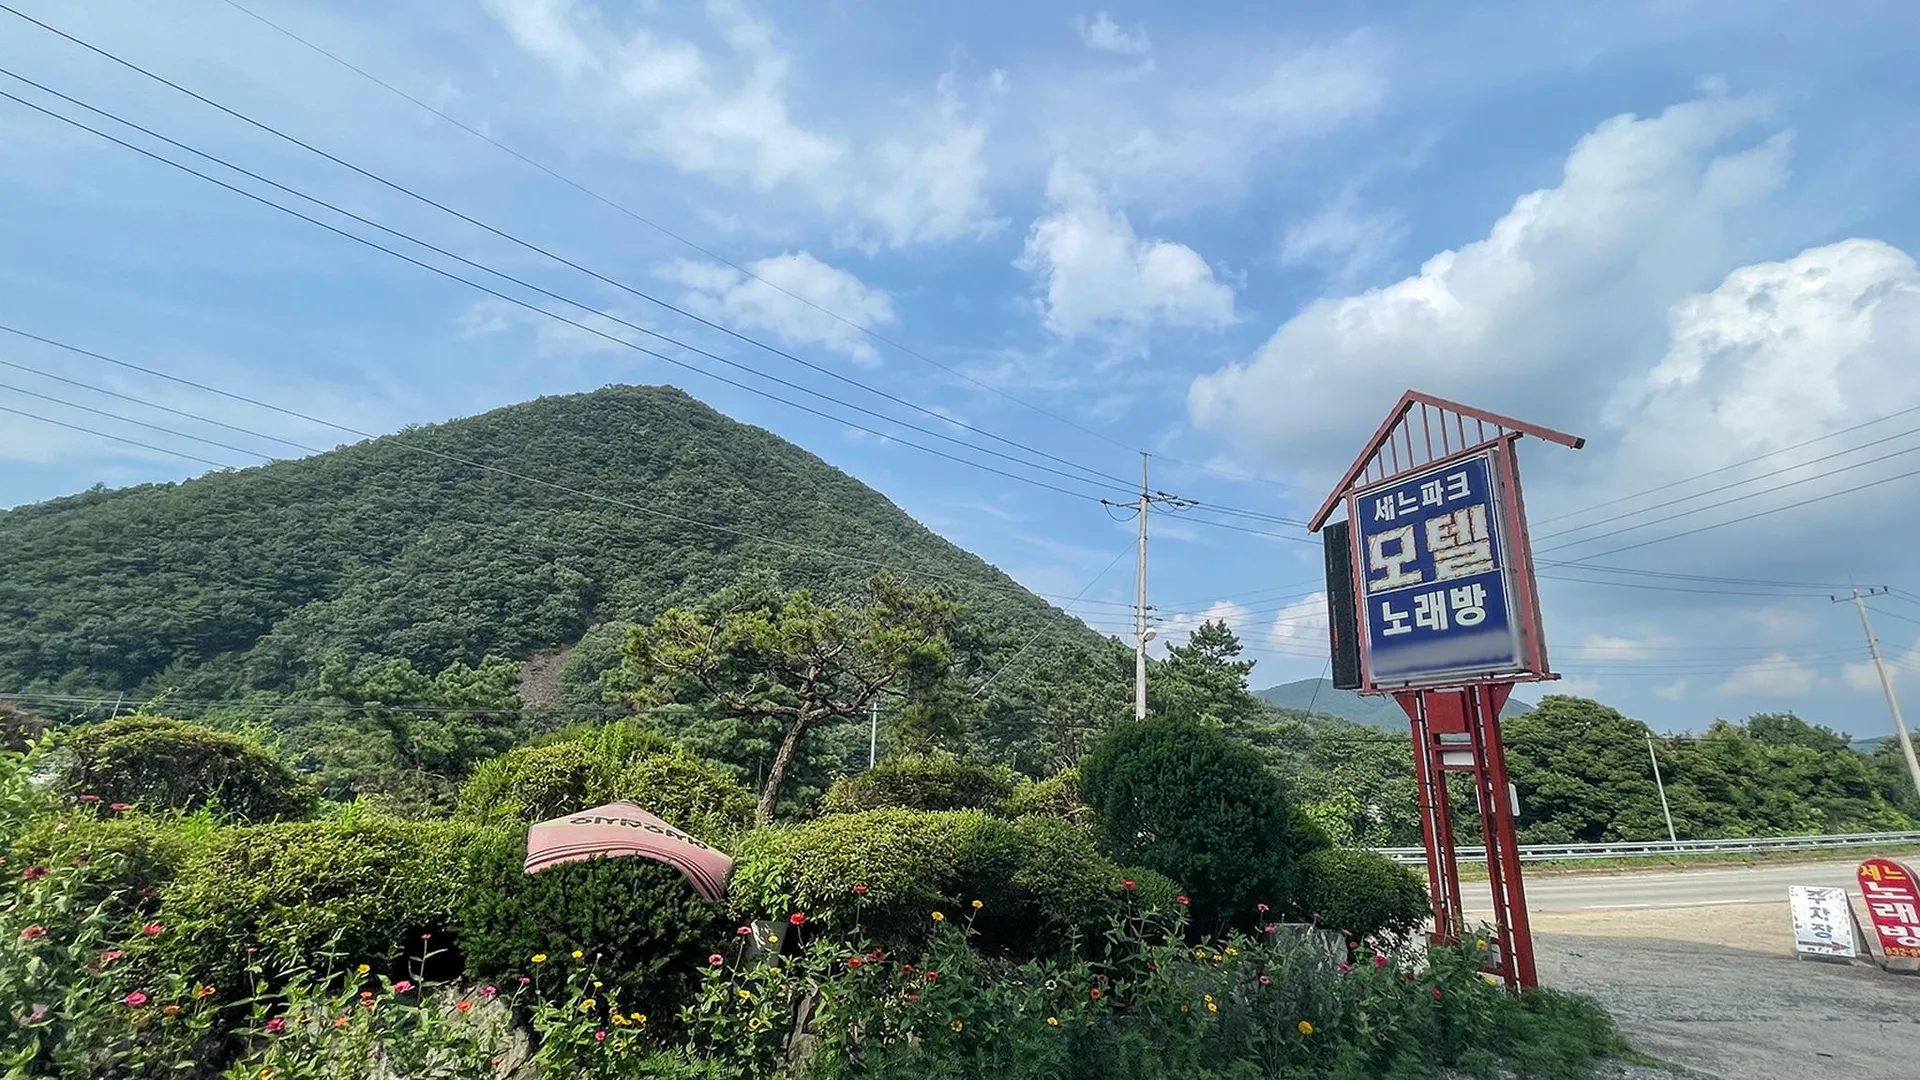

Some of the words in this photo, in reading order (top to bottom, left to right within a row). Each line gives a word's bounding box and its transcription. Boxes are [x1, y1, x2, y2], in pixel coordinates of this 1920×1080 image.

[1374, 471, 1471, 521] 세느파크
[1366, 503, 1494, 592] 모텔
[1382, 583, 1487, 636] 노래방
[1860, 864, 1906, 881] 세느
[1805, 889, 1834, 939] 주차장
